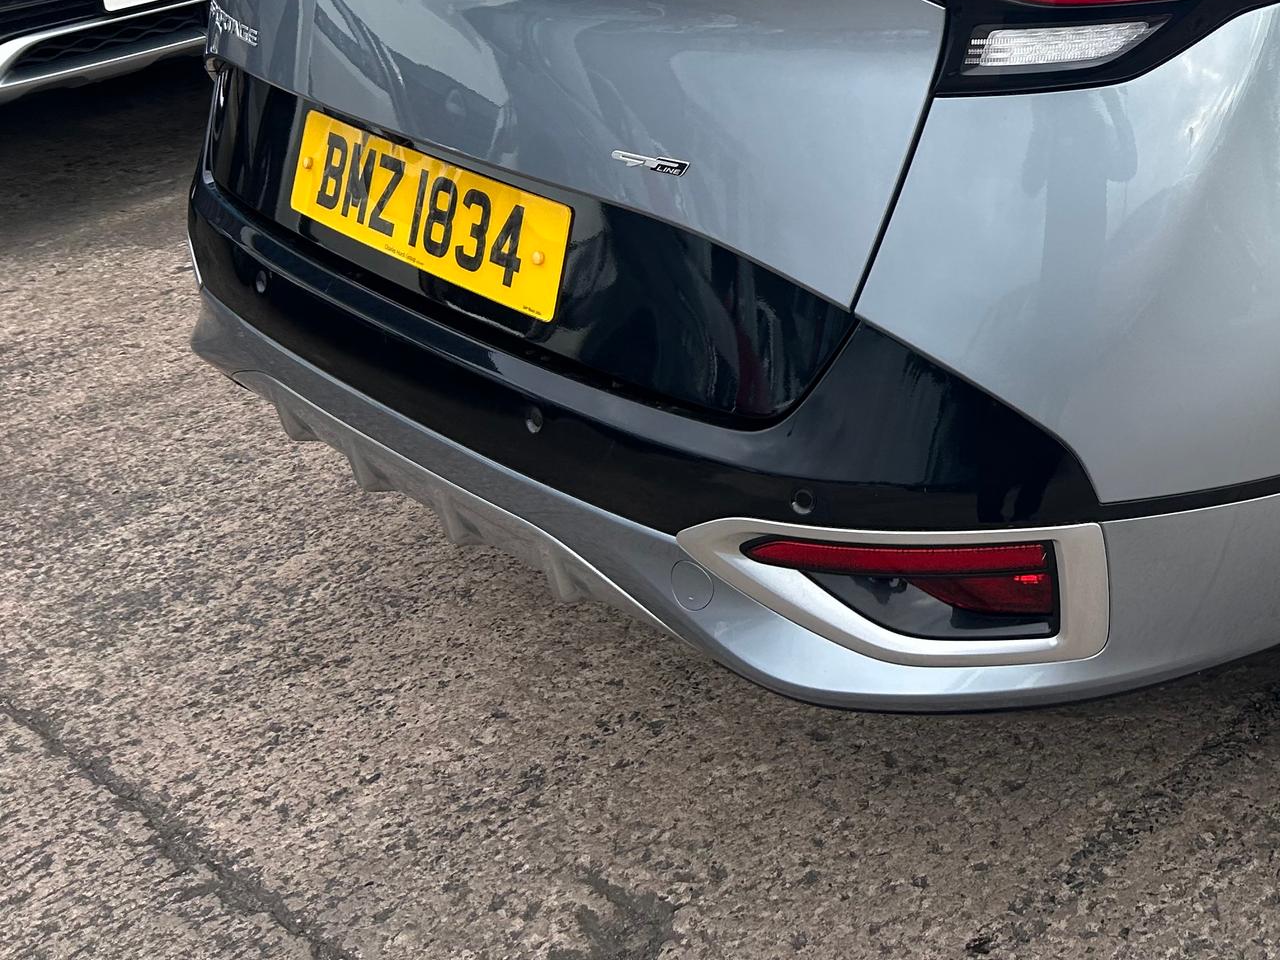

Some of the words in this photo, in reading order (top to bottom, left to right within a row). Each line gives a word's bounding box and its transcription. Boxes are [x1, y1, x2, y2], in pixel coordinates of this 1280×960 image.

[316, 131, 406, 238] BMZ
[407, 169, 526, 289] 1834
[656, 165, 682, 176] LINE
